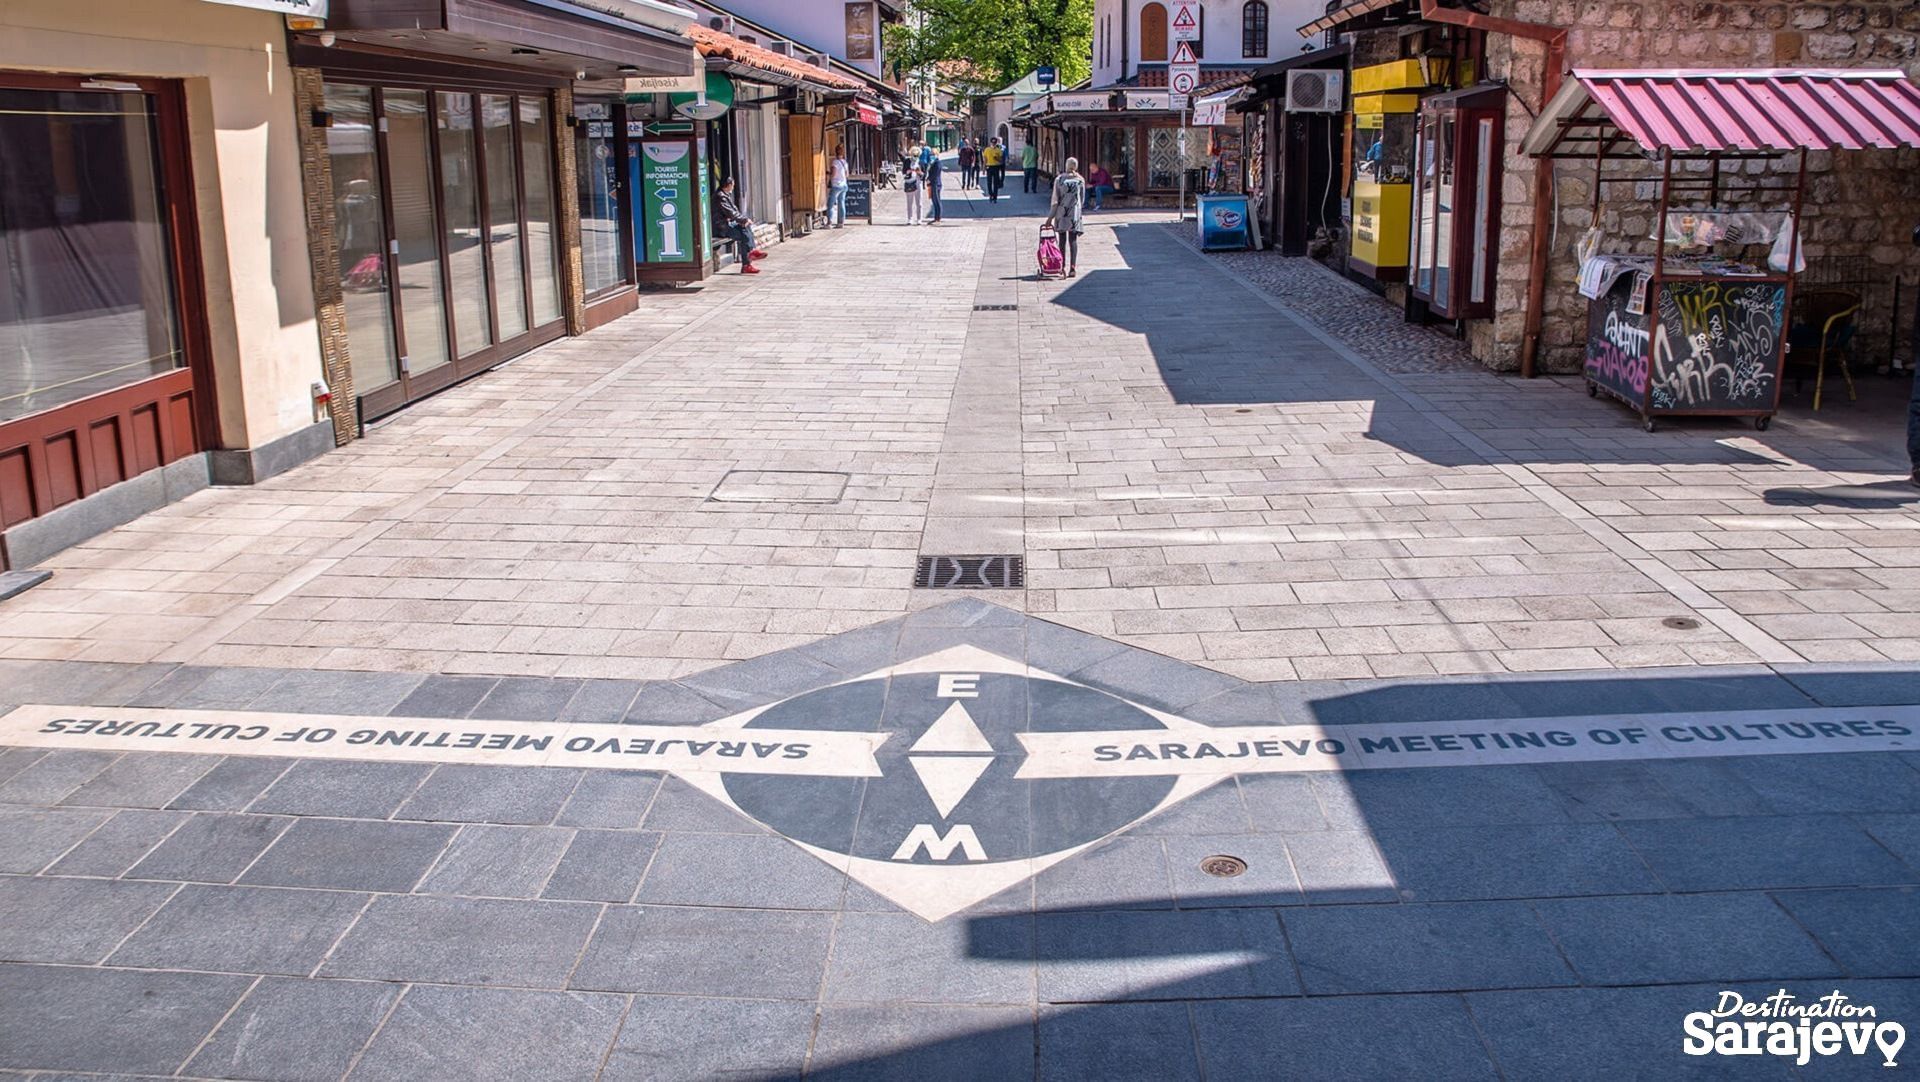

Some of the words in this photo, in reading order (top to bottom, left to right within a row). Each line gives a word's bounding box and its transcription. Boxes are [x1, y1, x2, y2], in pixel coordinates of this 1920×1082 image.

[936, 673, 981, 698] E
[38, 718, 271, 741] CULTURES
[272, 727, 338, 743] OF
[345, 729, 554, 751] MEETING
[1093, 738, 1346, 762] SARAJEVO
[1357, 730, 1578, 755] MEETING
[1586, 727, 1648, 746] OF
[1660, 719, 1914, 744] CULTURES
[564, 736, 813, 760] SARAJEVO
